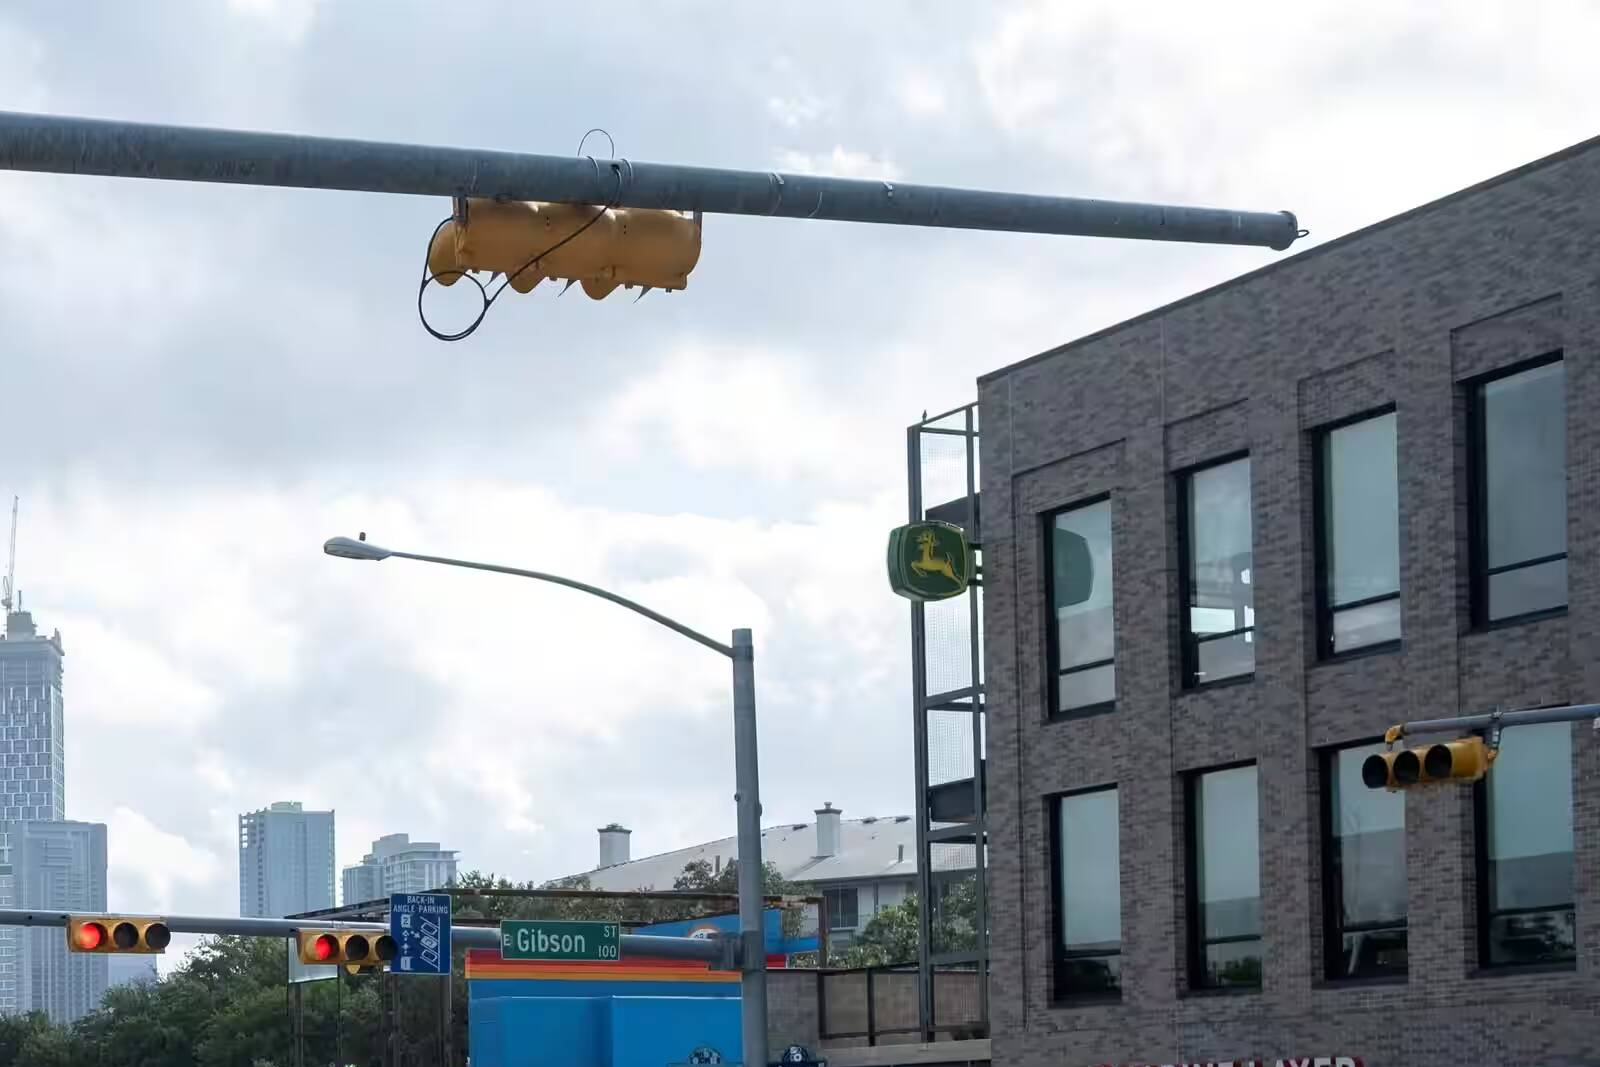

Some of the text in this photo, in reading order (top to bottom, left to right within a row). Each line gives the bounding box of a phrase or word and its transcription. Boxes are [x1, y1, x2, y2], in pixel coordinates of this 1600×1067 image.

[407, 895, 435, 904] BACK-IN
[393, 904, 449, 914] ANGLE PARKING
[603, 925, 617, 938] ST
[517, 928, 586, 953] Gibson
[598, 945, 617, 958] 100
